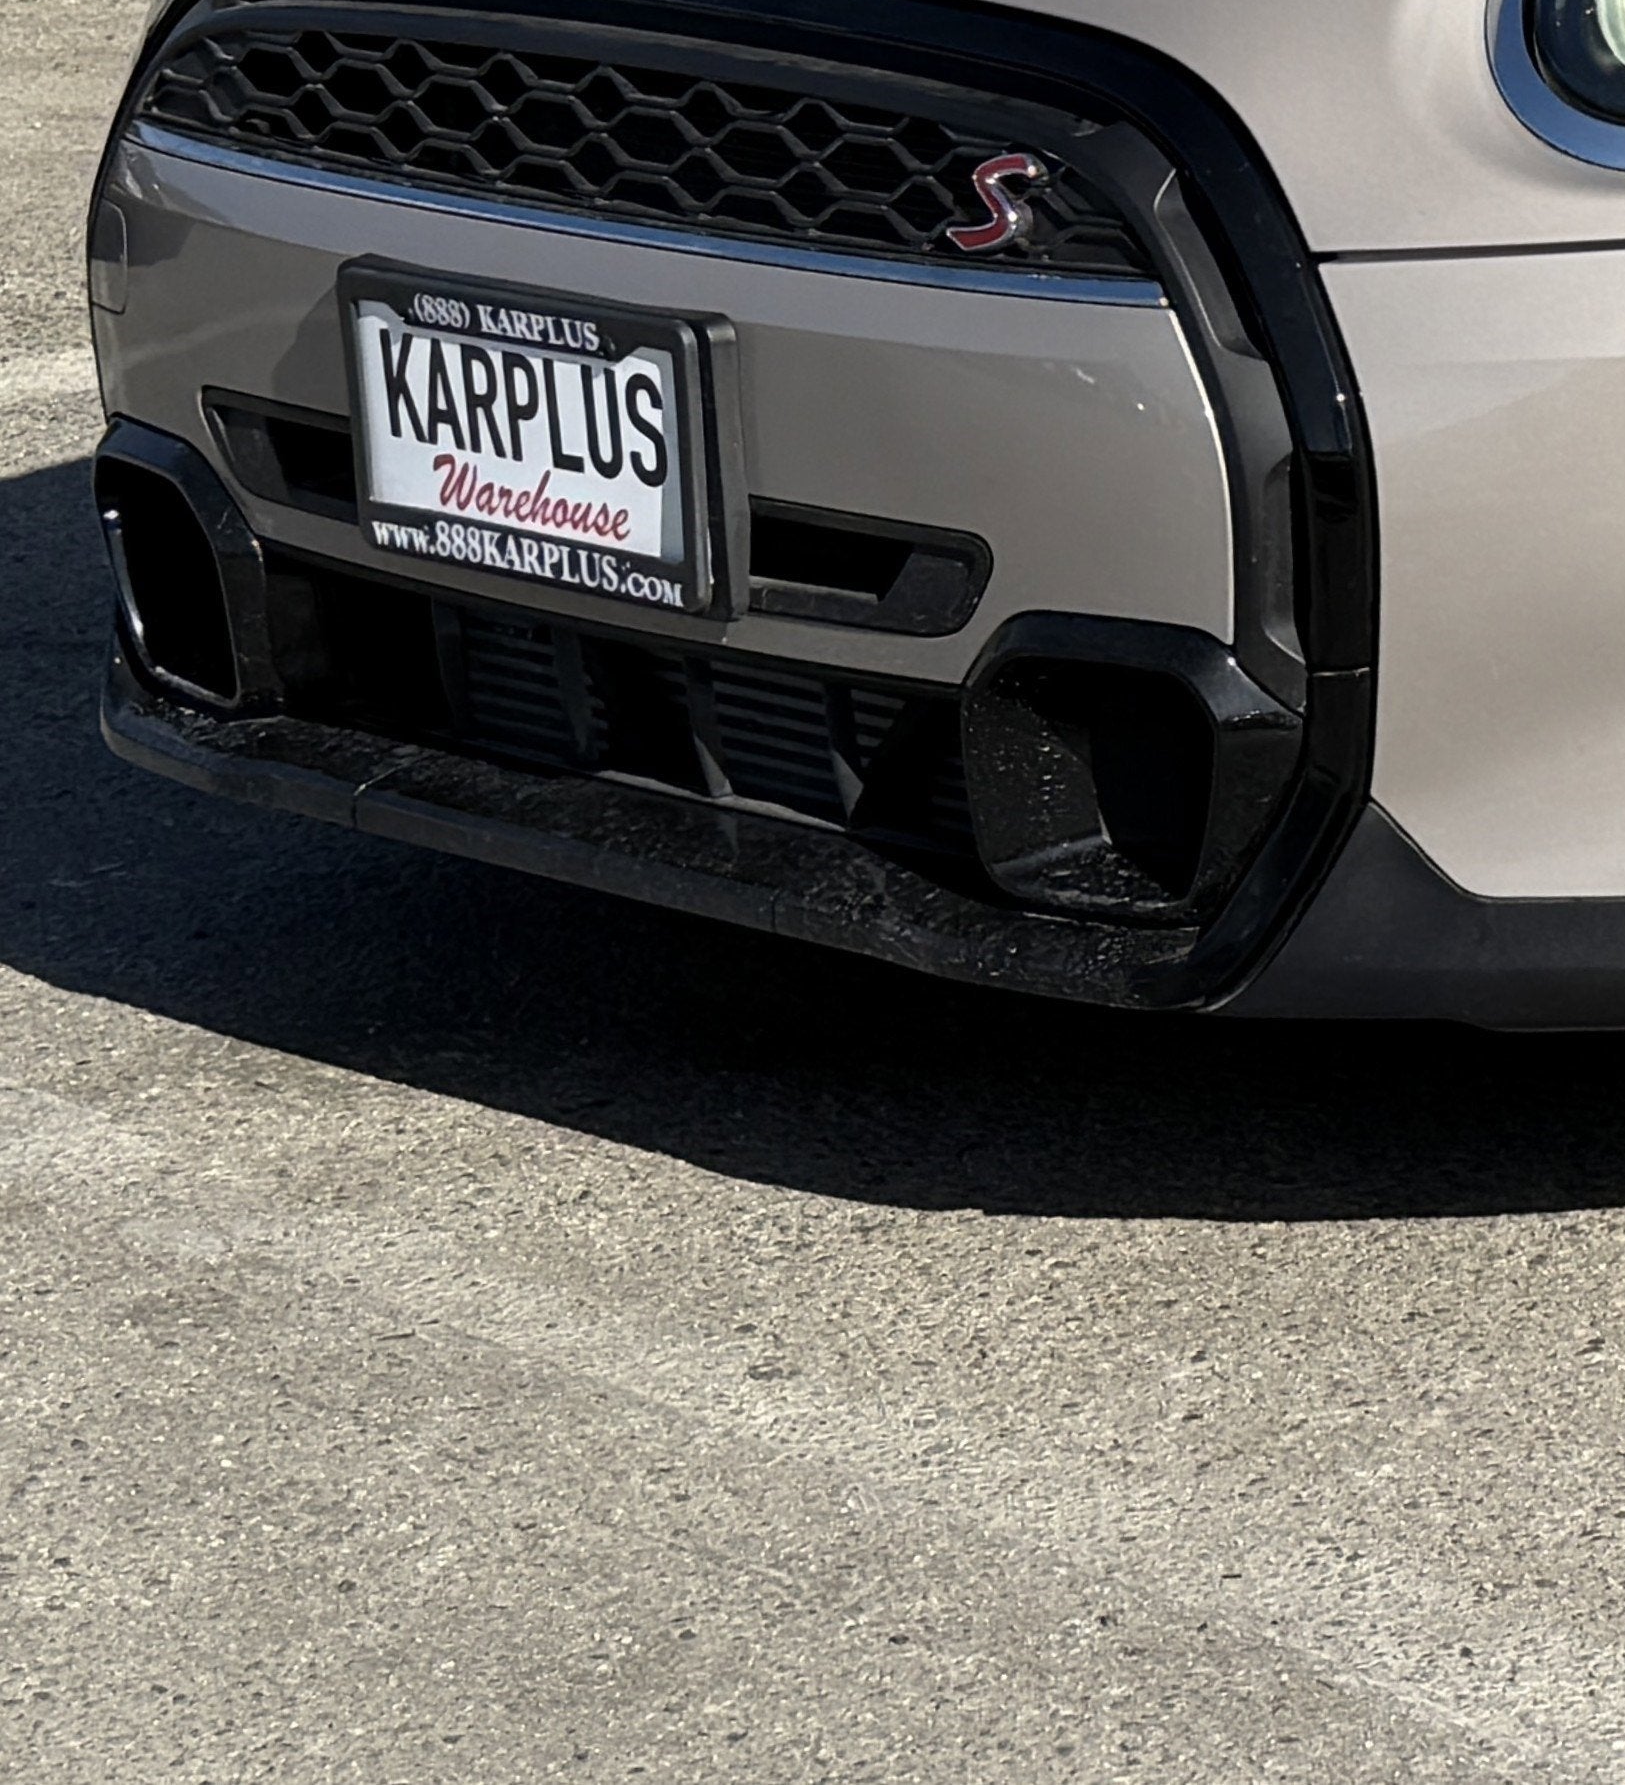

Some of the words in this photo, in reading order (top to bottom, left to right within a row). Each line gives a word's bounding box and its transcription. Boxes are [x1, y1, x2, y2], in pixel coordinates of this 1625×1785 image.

[946, 152, 1049, 252] S
[413, 293, 471, 330] (888)
[475, 303, 600, 352] KARPLUS
[378, 327, 669, 488] KARPLUS
[432, 453, 632, 542] Warehouse
